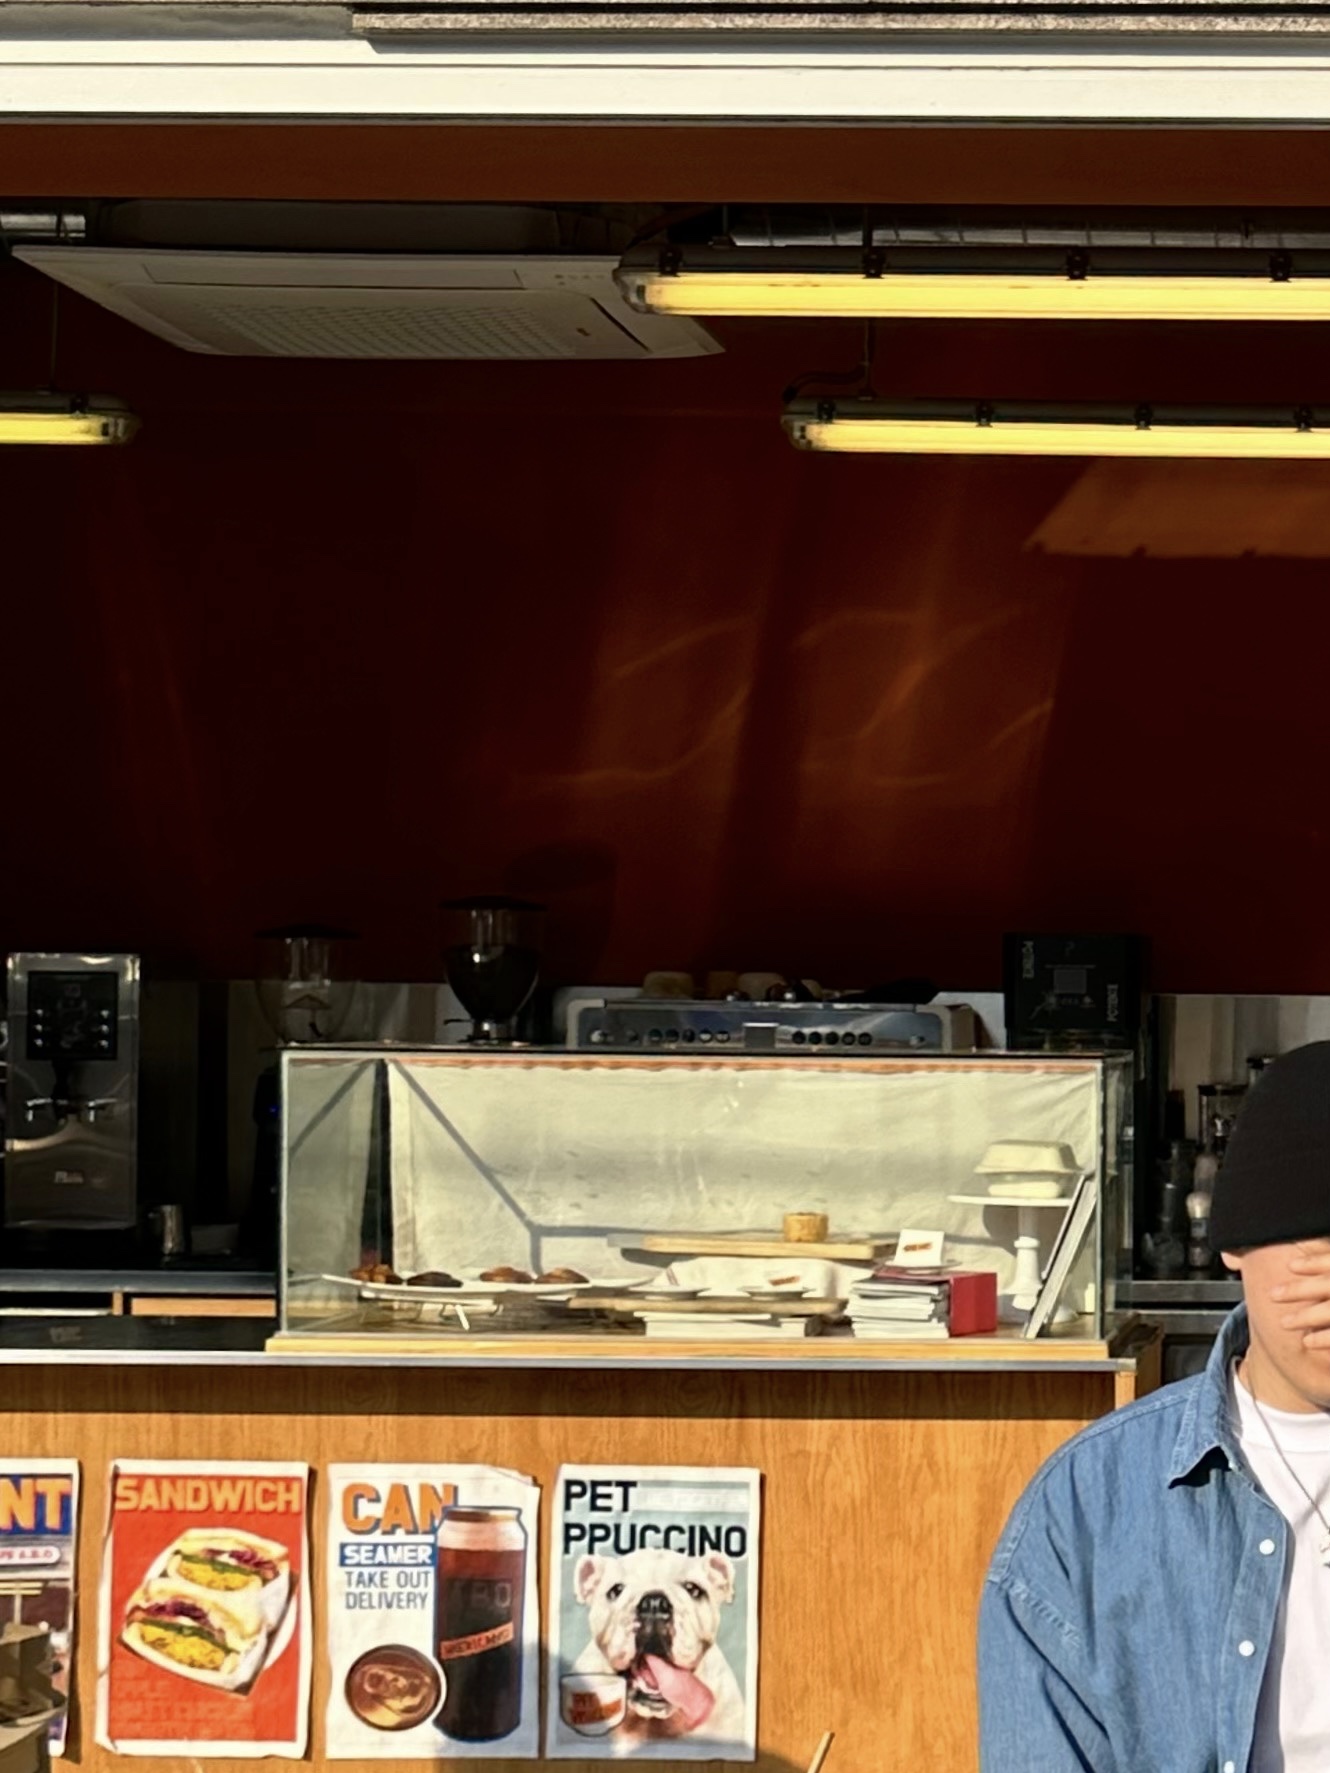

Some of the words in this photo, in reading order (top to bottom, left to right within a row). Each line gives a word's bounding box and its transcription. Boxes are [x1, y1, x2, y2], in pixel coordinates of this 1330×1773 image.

[114, 1477, 301, 1514] SANDWICH
[342, 1483, 458, 1535] CAN
[564, 1479, 637, 1512] PET
[344, 1545, 433, 1564] SEAMER
[564, 1523, 746, 1557] PPUCCINO
[345, 1571, 389, 1588] TAKE
[396, 1571, 431, 1588] OUT
[345, 1592, 428, 1610] DELIVERY
